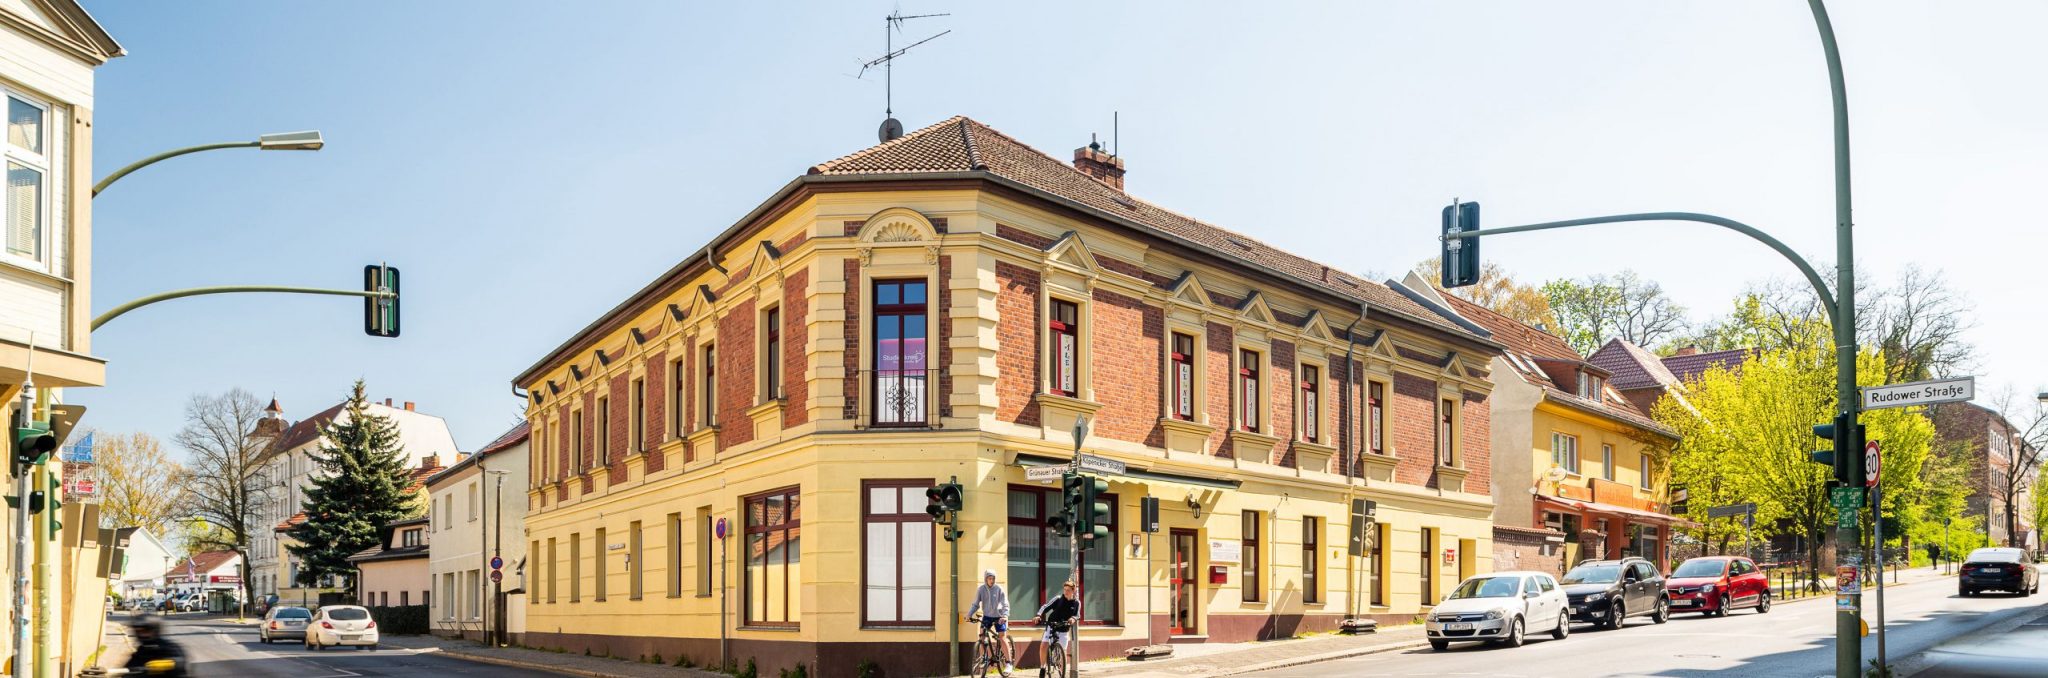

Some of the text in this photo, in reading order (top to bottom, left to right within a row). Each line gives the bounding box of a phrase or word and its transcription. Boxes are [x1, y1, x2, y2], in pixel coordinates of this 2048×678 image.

[1872, 385, 1963, 402] Rudower Straße
[1865, 454, 1876, 475] 30
